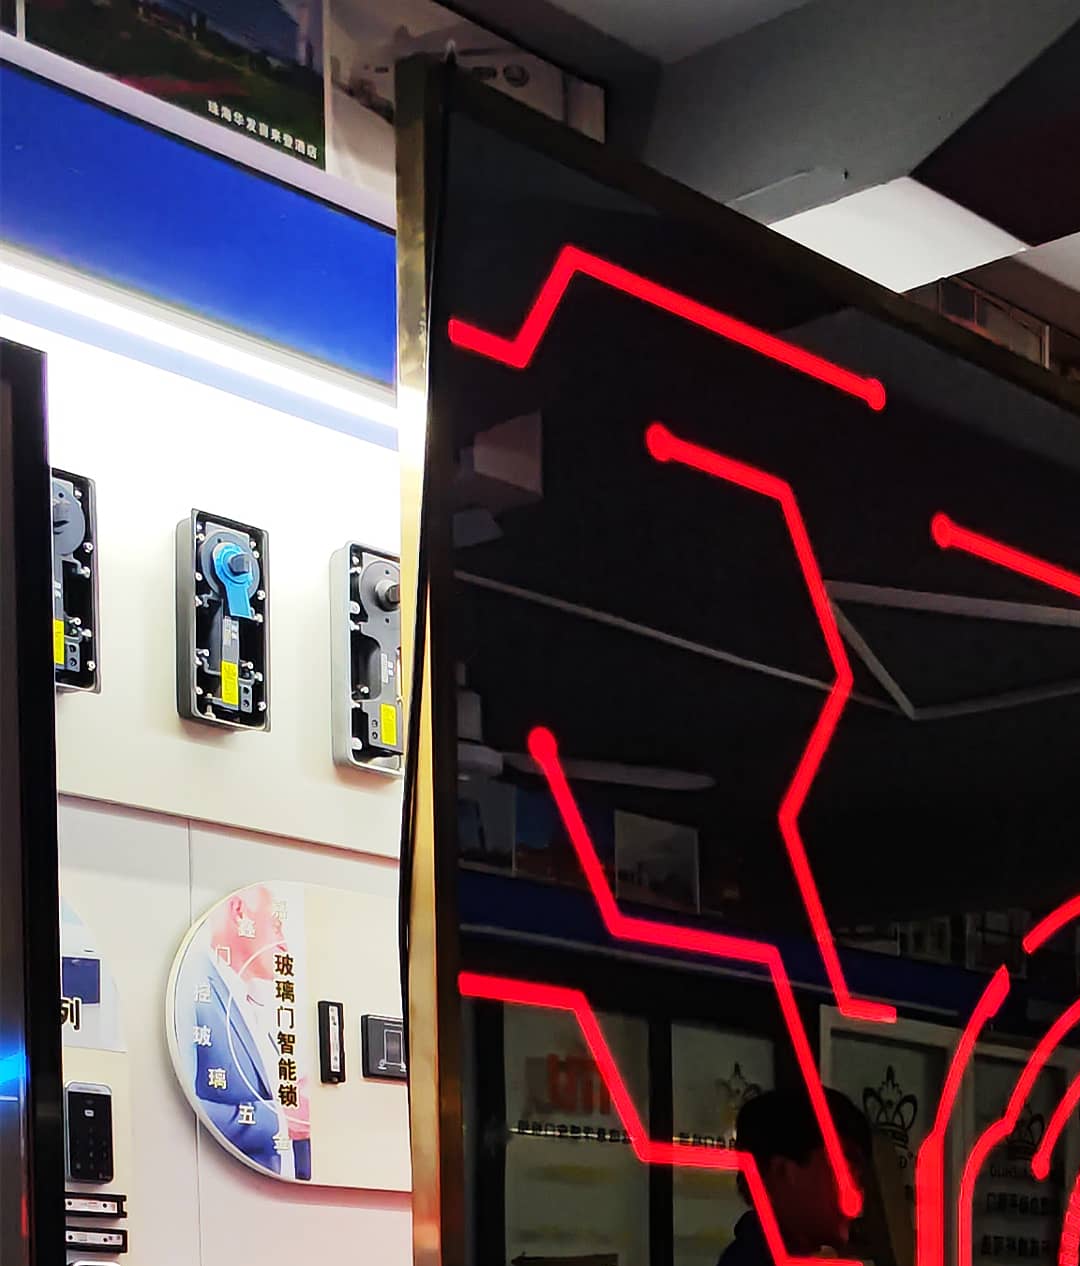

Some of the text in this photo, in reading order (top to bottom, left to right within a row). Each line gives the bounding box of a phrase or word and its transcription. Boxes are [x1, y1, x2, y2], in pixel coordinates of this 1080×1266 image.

[273, 952, 299, 1109] 玻璃门智能锁
